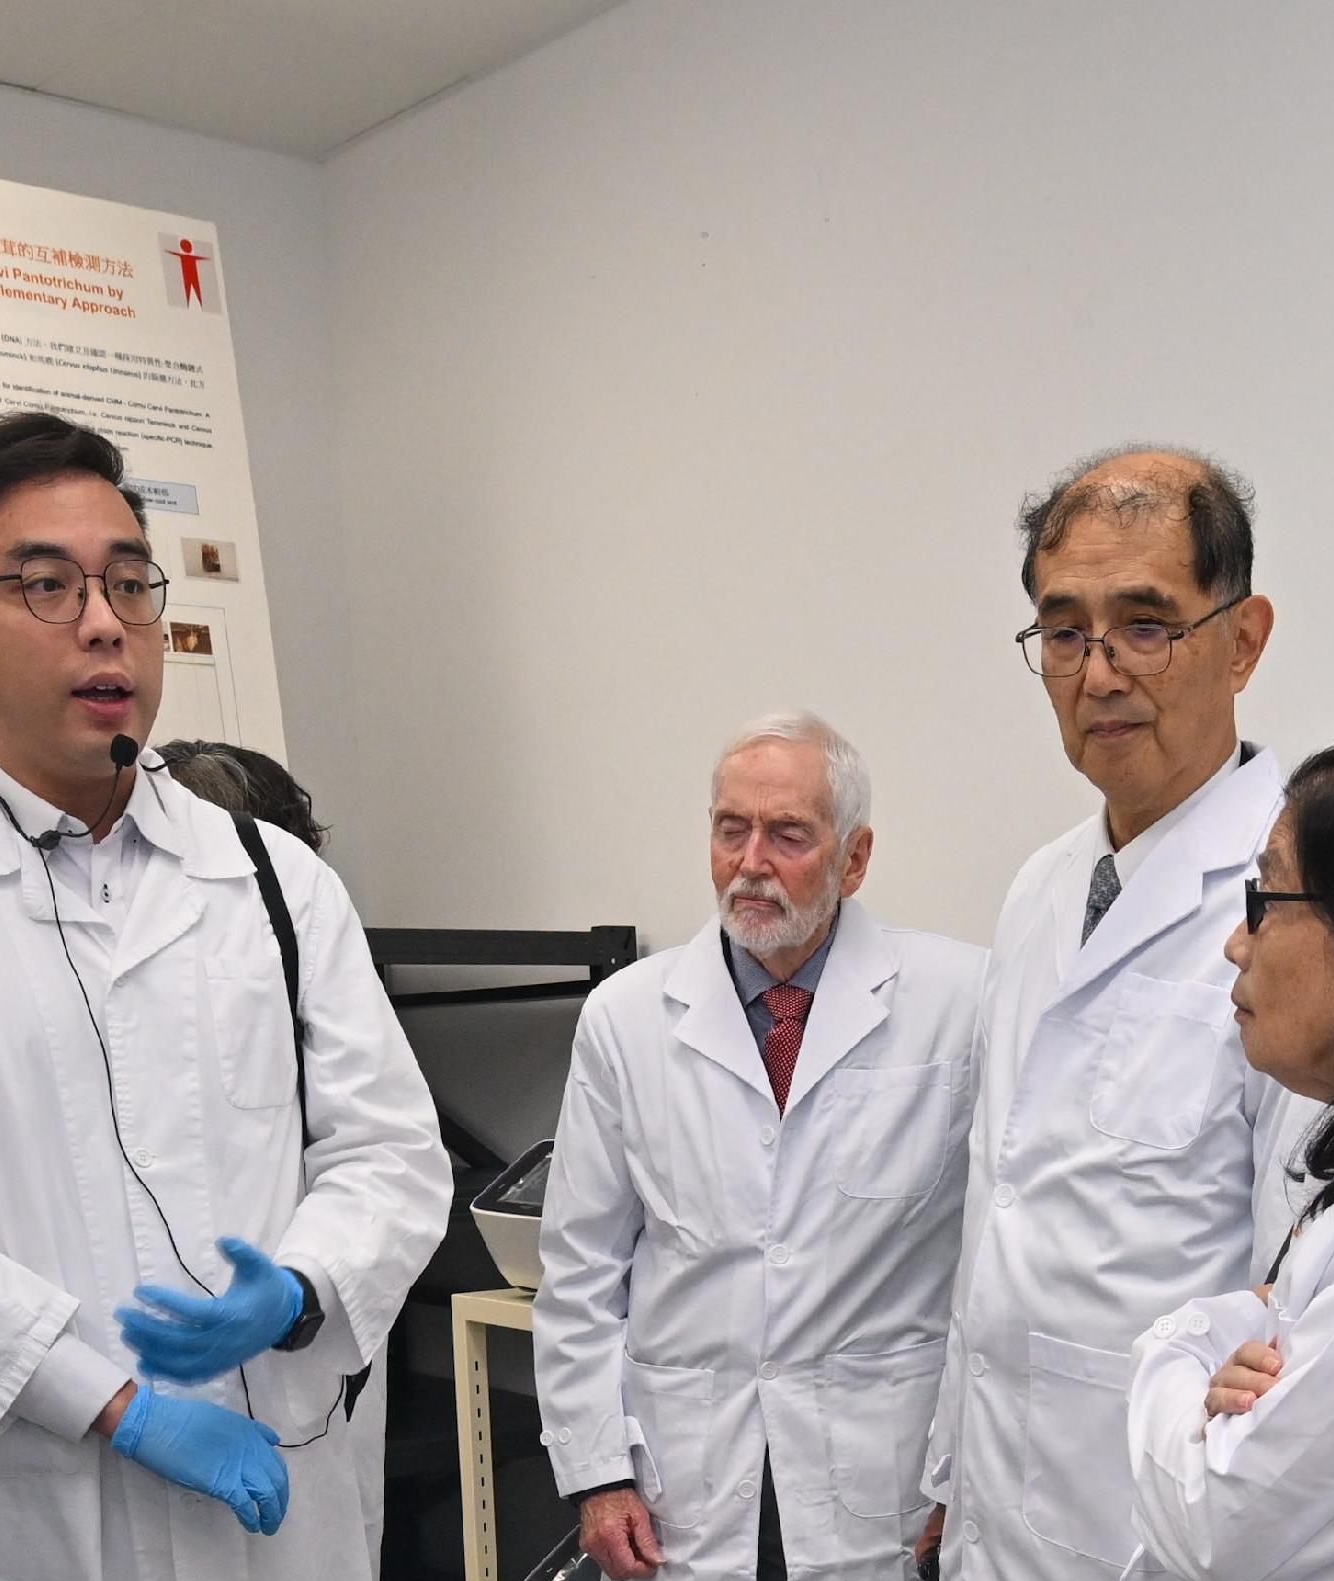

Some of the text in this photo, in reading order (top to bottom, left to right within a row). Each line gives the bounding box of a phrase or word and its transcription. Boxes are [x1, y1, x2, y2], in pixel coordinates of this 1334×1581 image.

[13, 268, 103, 296] Pantotrichum
[107, 285, 124, 301] by
[72, 298, 137, 319] Approach
